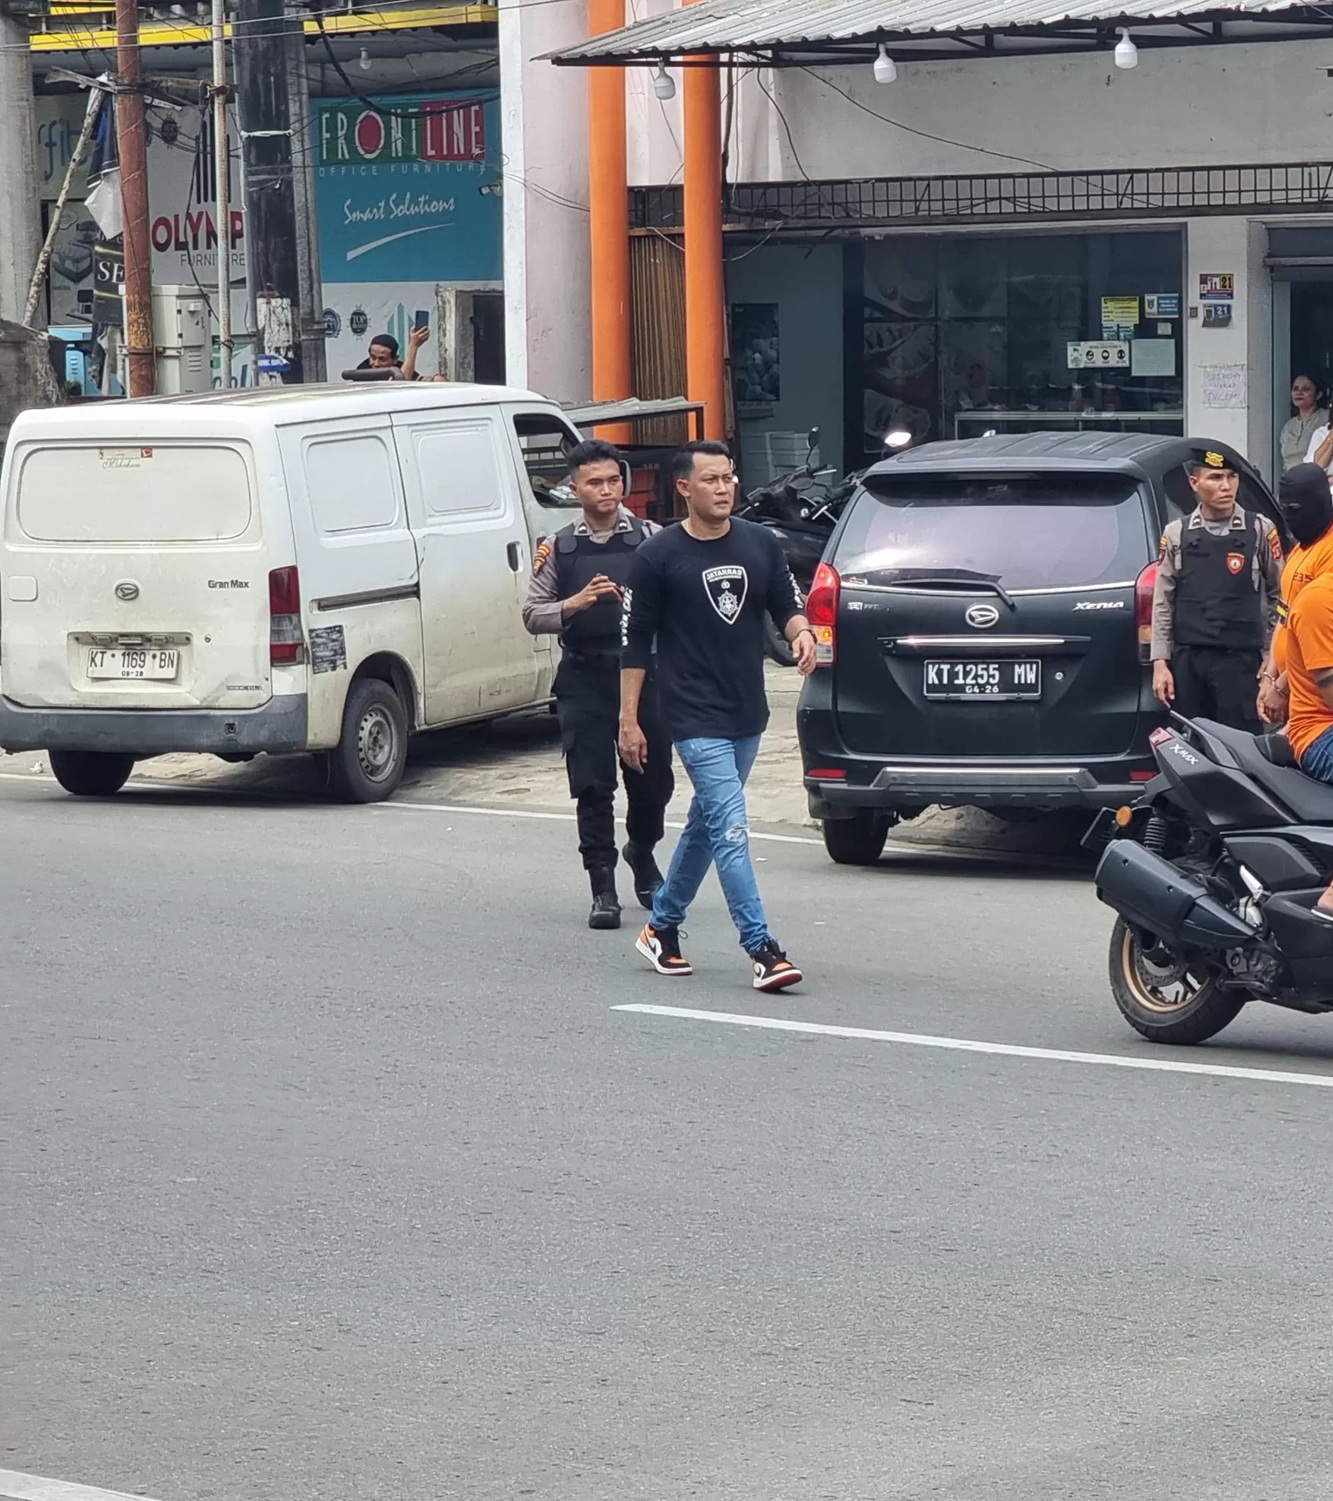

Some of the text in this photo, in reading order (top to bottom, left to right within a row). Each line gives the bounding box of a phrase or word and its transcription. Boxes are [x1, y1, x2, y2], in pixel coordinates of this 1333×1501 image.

[322, 105, 480, 160] FRONTLINE
[319, 165, 378, 177] OFFICE
[344, 192, 455, 225] Smart Solutions
[180, 253, 246, 267] FURNIRE
[208, 580, 250, 589] Gran Max
[89, 650, 175, 669] KT 1169 BN
[927, 663, 1037, 684] KT 1255 MW
